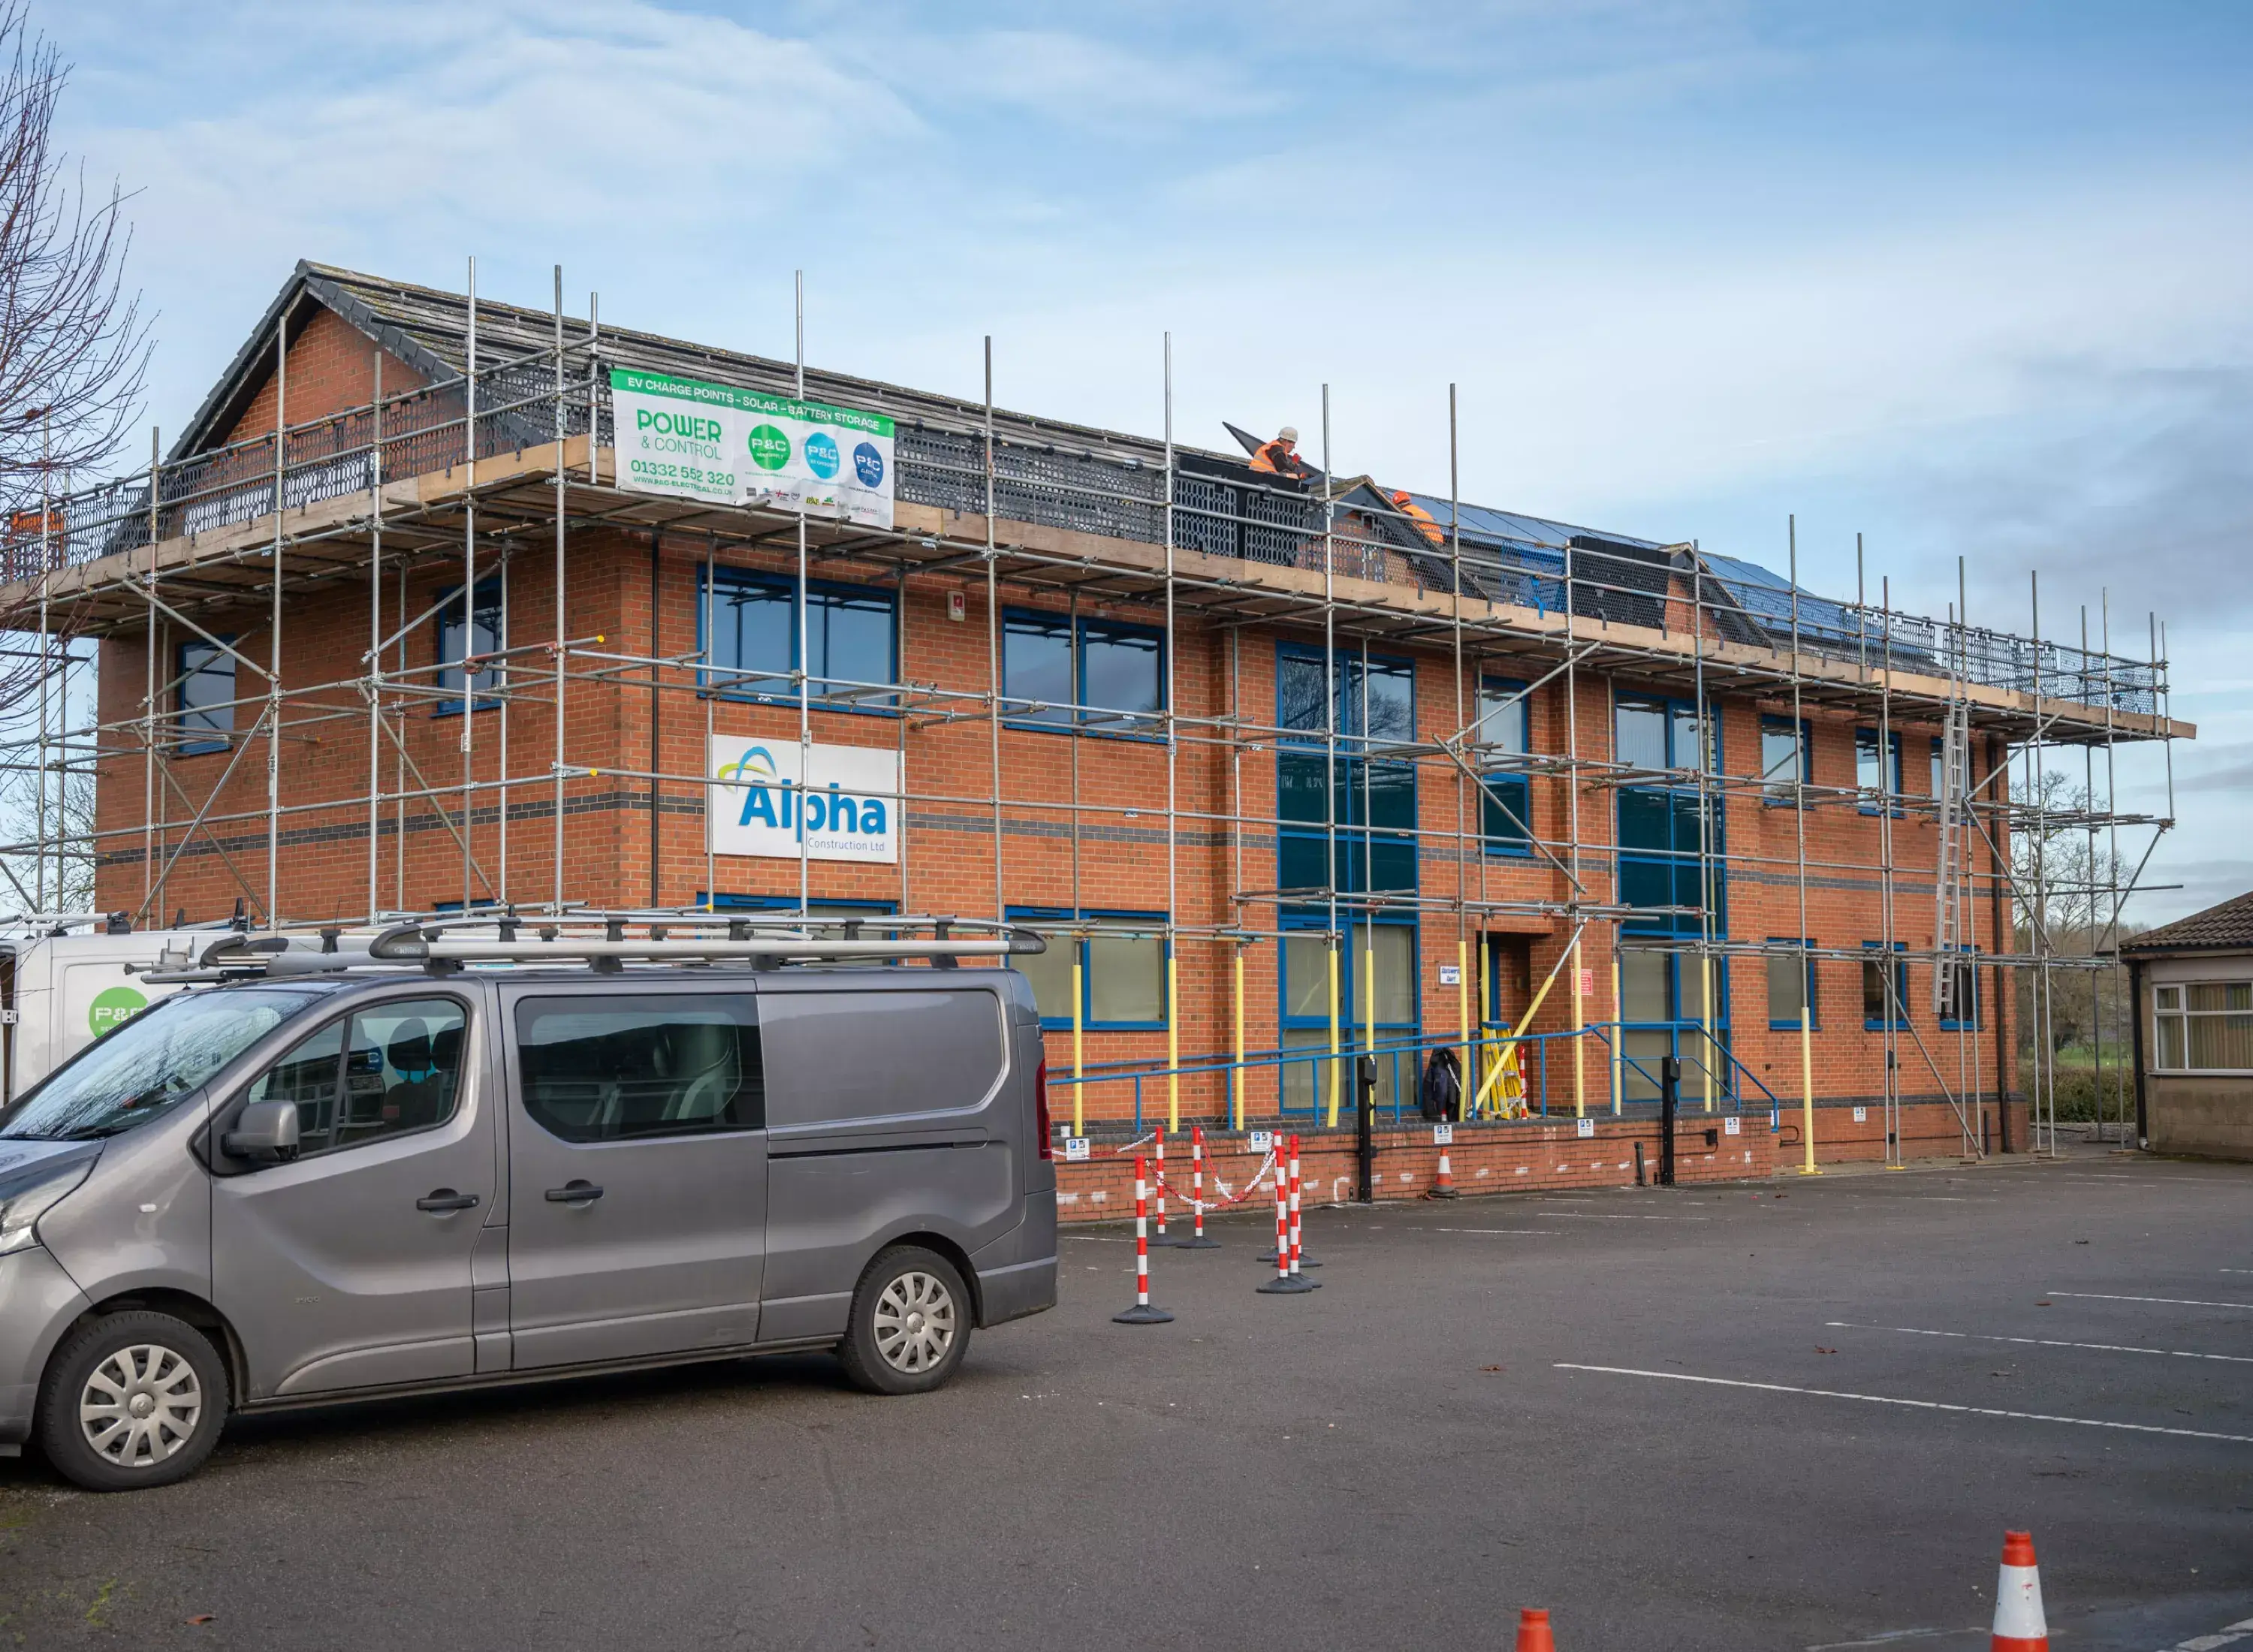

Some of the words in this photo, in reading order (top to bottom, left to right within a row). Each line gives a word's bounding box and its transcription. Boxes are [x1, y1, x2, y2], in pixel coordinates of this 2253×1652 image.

[628, 377, 643, 387] EV
[645, 380, 692, 396] CHARGE
[694, 387, 734, 403] POINTS
[743, 396, 778, 412] SOLAR
[788, 405, 832, 421] BATTERY
[835, 413, 879, 430] STORAGE
[637, 408, 722, 443] POWER
[641, 436, 650, 449] &
[655, 437, 722, 460] CONTROL
[752, 438, 786, 452] P&C
[807, 445, 837, 460] P&C
[631, 460, 677, 477] 01332
[680, 466, 704, 483] 552
[707, 471, 735, 486] 320
[856, 454, 881, 472] P&C
[739, 779, 886, 843] Alpha
[808, 837, 867, 851] Construction
[870, 842, 885, 852] Ltd
